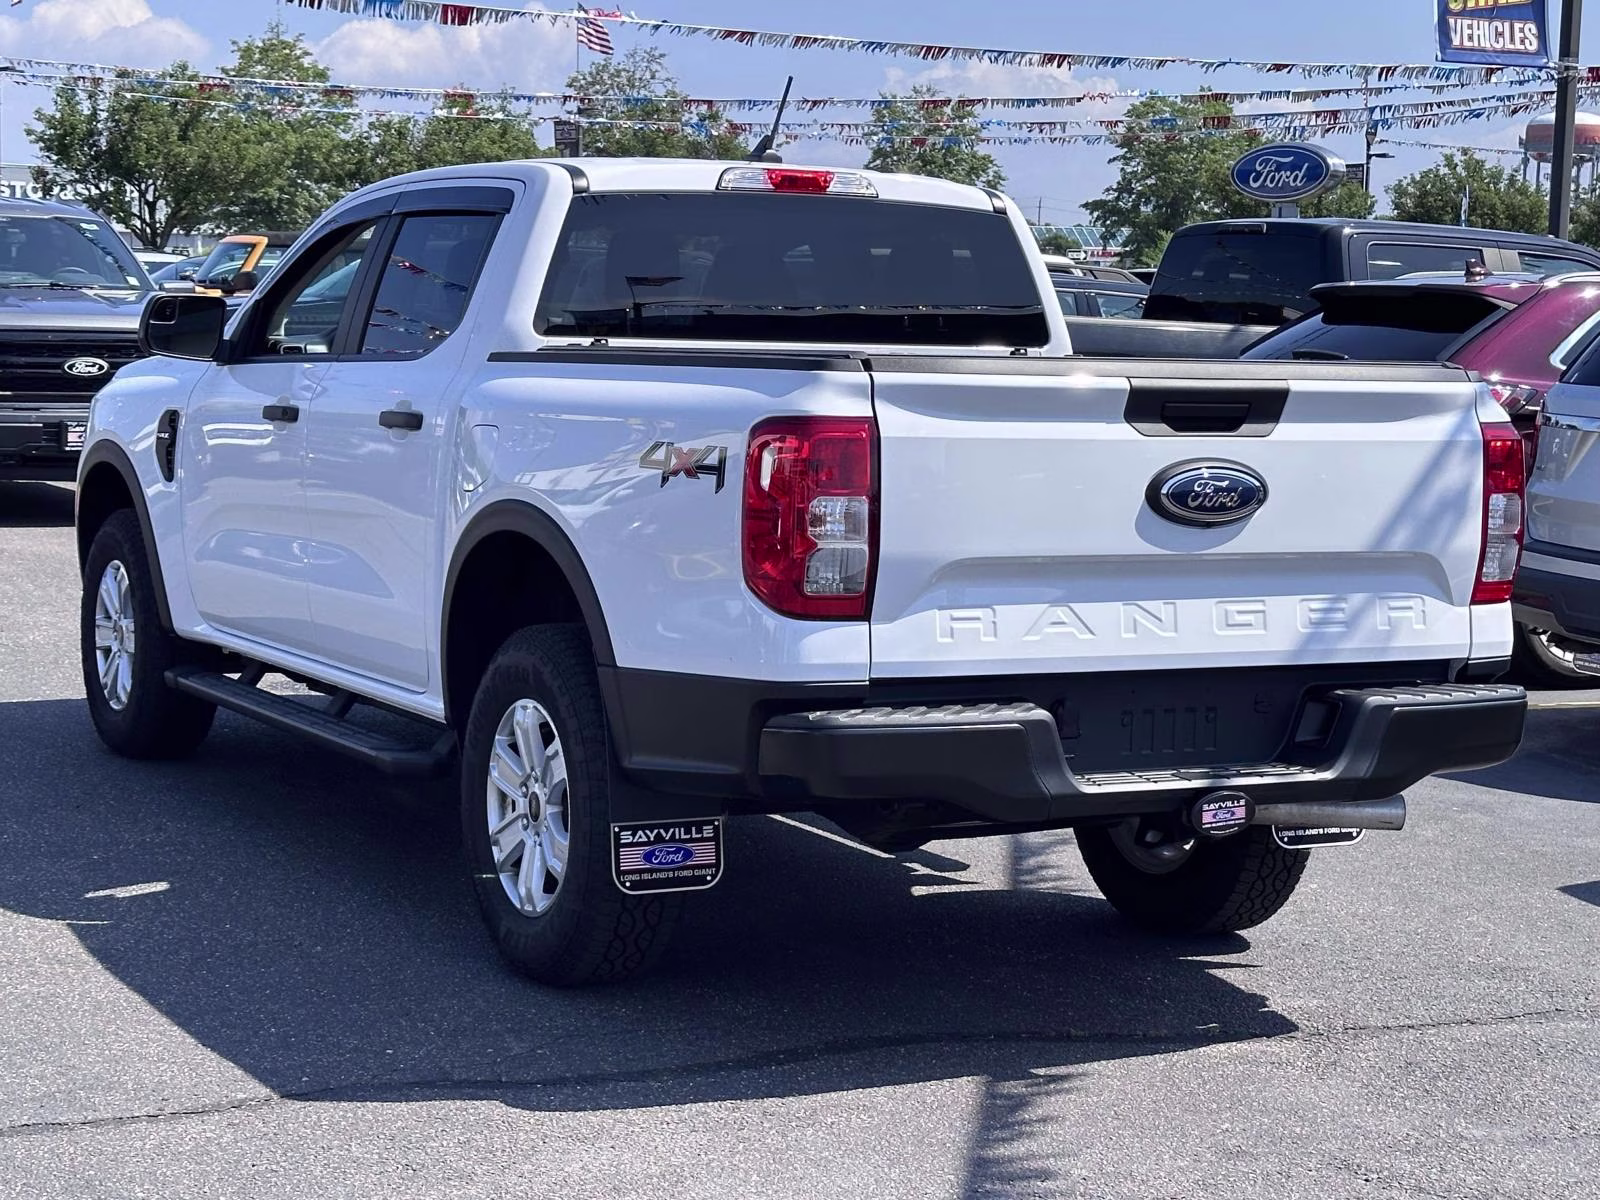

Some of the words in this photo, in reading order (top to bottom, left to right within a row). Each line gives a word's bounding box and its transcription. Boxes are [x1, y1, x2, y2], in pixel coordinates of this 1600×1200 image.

[1448, 17, 1539, 51] VEHICLES
[1250, 156, 1309, 188] Ford
[72, 361, 100, 373] Ford
[1187, 479, 1243, 508] Ford
[935, 594, 1428, 643] RANGER
[1202, 799, 1246, 811] SAYVILLE
[620, 825, 714, 843] SAYVILLE
[652, 847, 684, 863] Ford
[641, 871, 674, 880] ISLAND'S
[674, 869, 693, 878] FORD
[694, 868, 716, 876] GIANT
